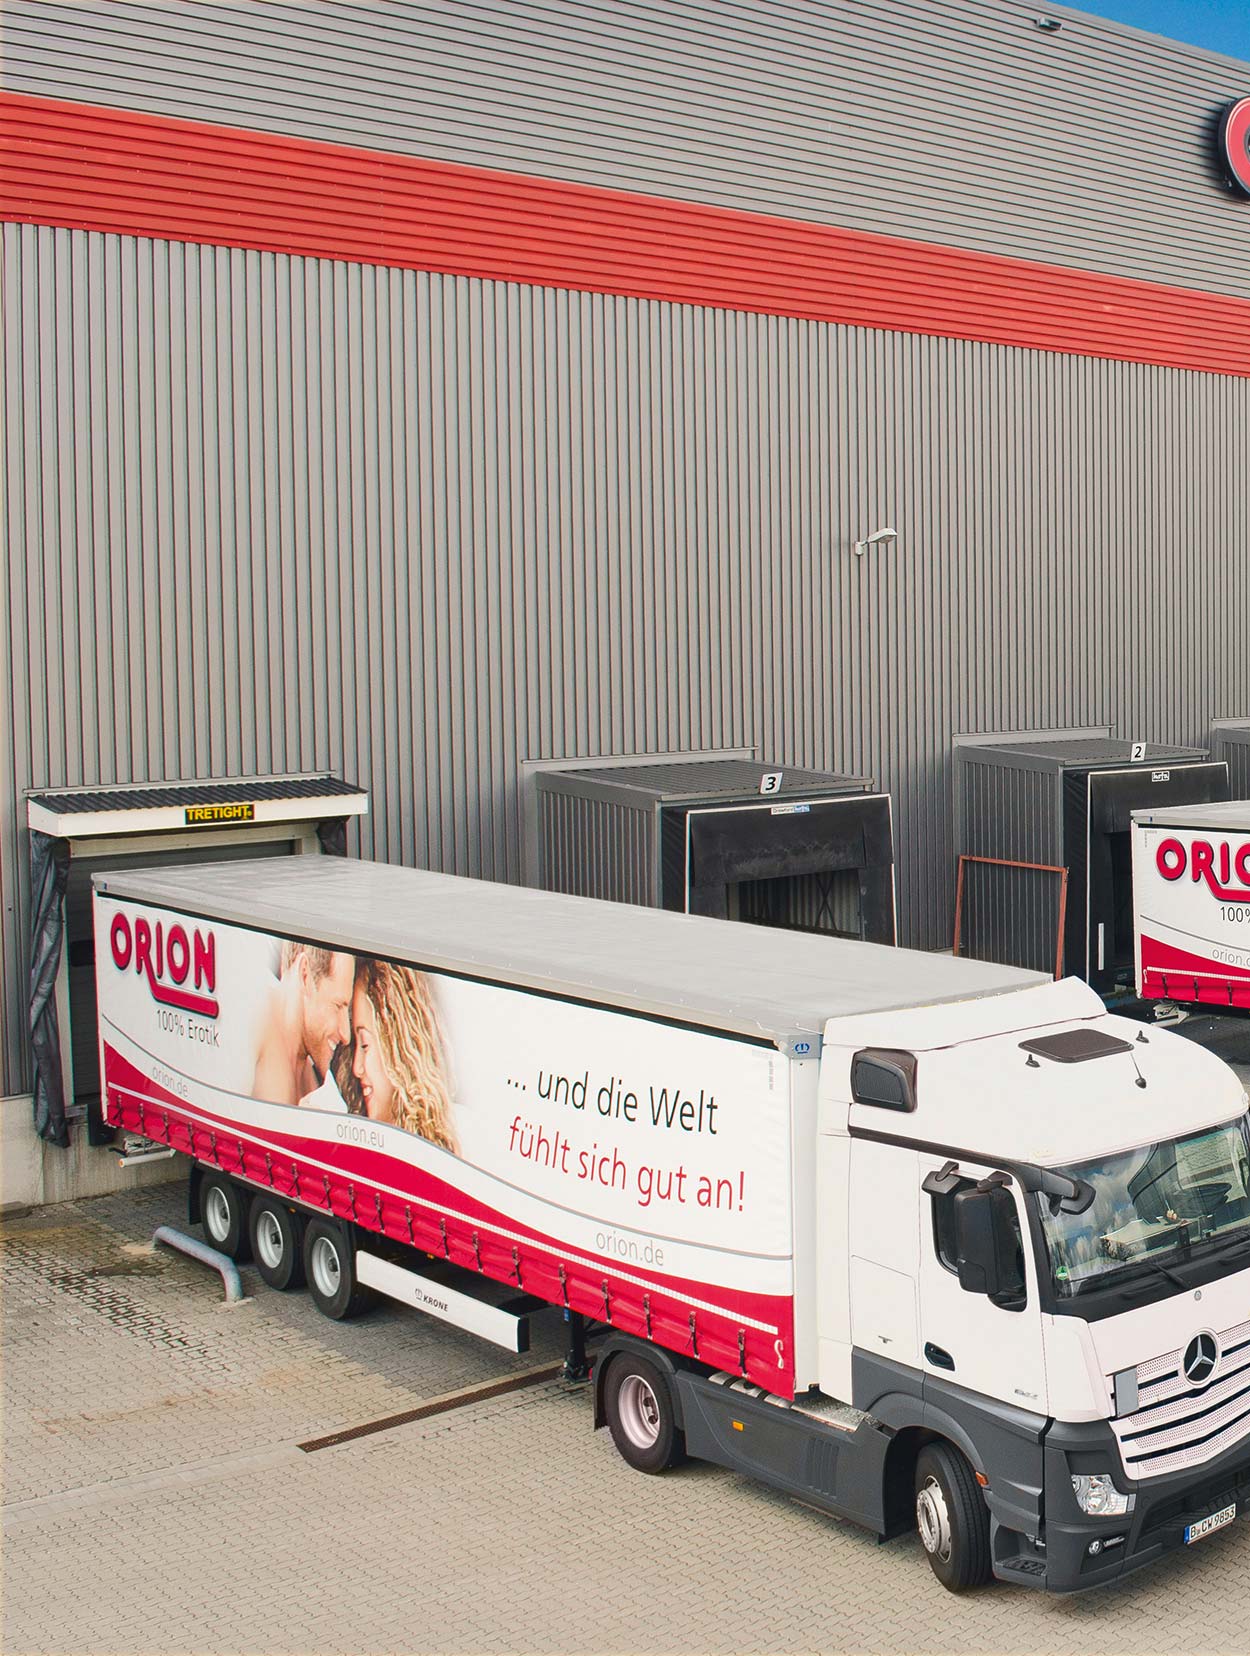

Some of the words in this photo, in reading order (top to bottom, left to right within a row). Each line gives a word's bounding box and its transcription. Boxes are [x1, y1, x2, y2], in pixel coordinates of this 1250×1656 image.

[1134, 745, 1142, 758] 2
[765, 777, 776, 790] 3
[110, 911, 219, 1019] ORION
[157, 1009, 185, 1037] 100%
[188, 1018, 219, 1048] Erotik
[152, 1065, 190, 1098] orion.de
[537, 1070, 589, 1110] und
[597, 1076, 638, 1122] die
[650, 1086, 718, 1135] Welt
[336, 1119, 385, 1148] orion.eu
[509, 1115, 571, 1174] fühlt
[577, 1143, 627, 1190] sich
[637, 1165, 687, 1207] gut
[696, 1170, 745, 1212] an!
[595, 1230, 664, 1266] orion.de
[423, 1295, 448, 1312] KRONE
